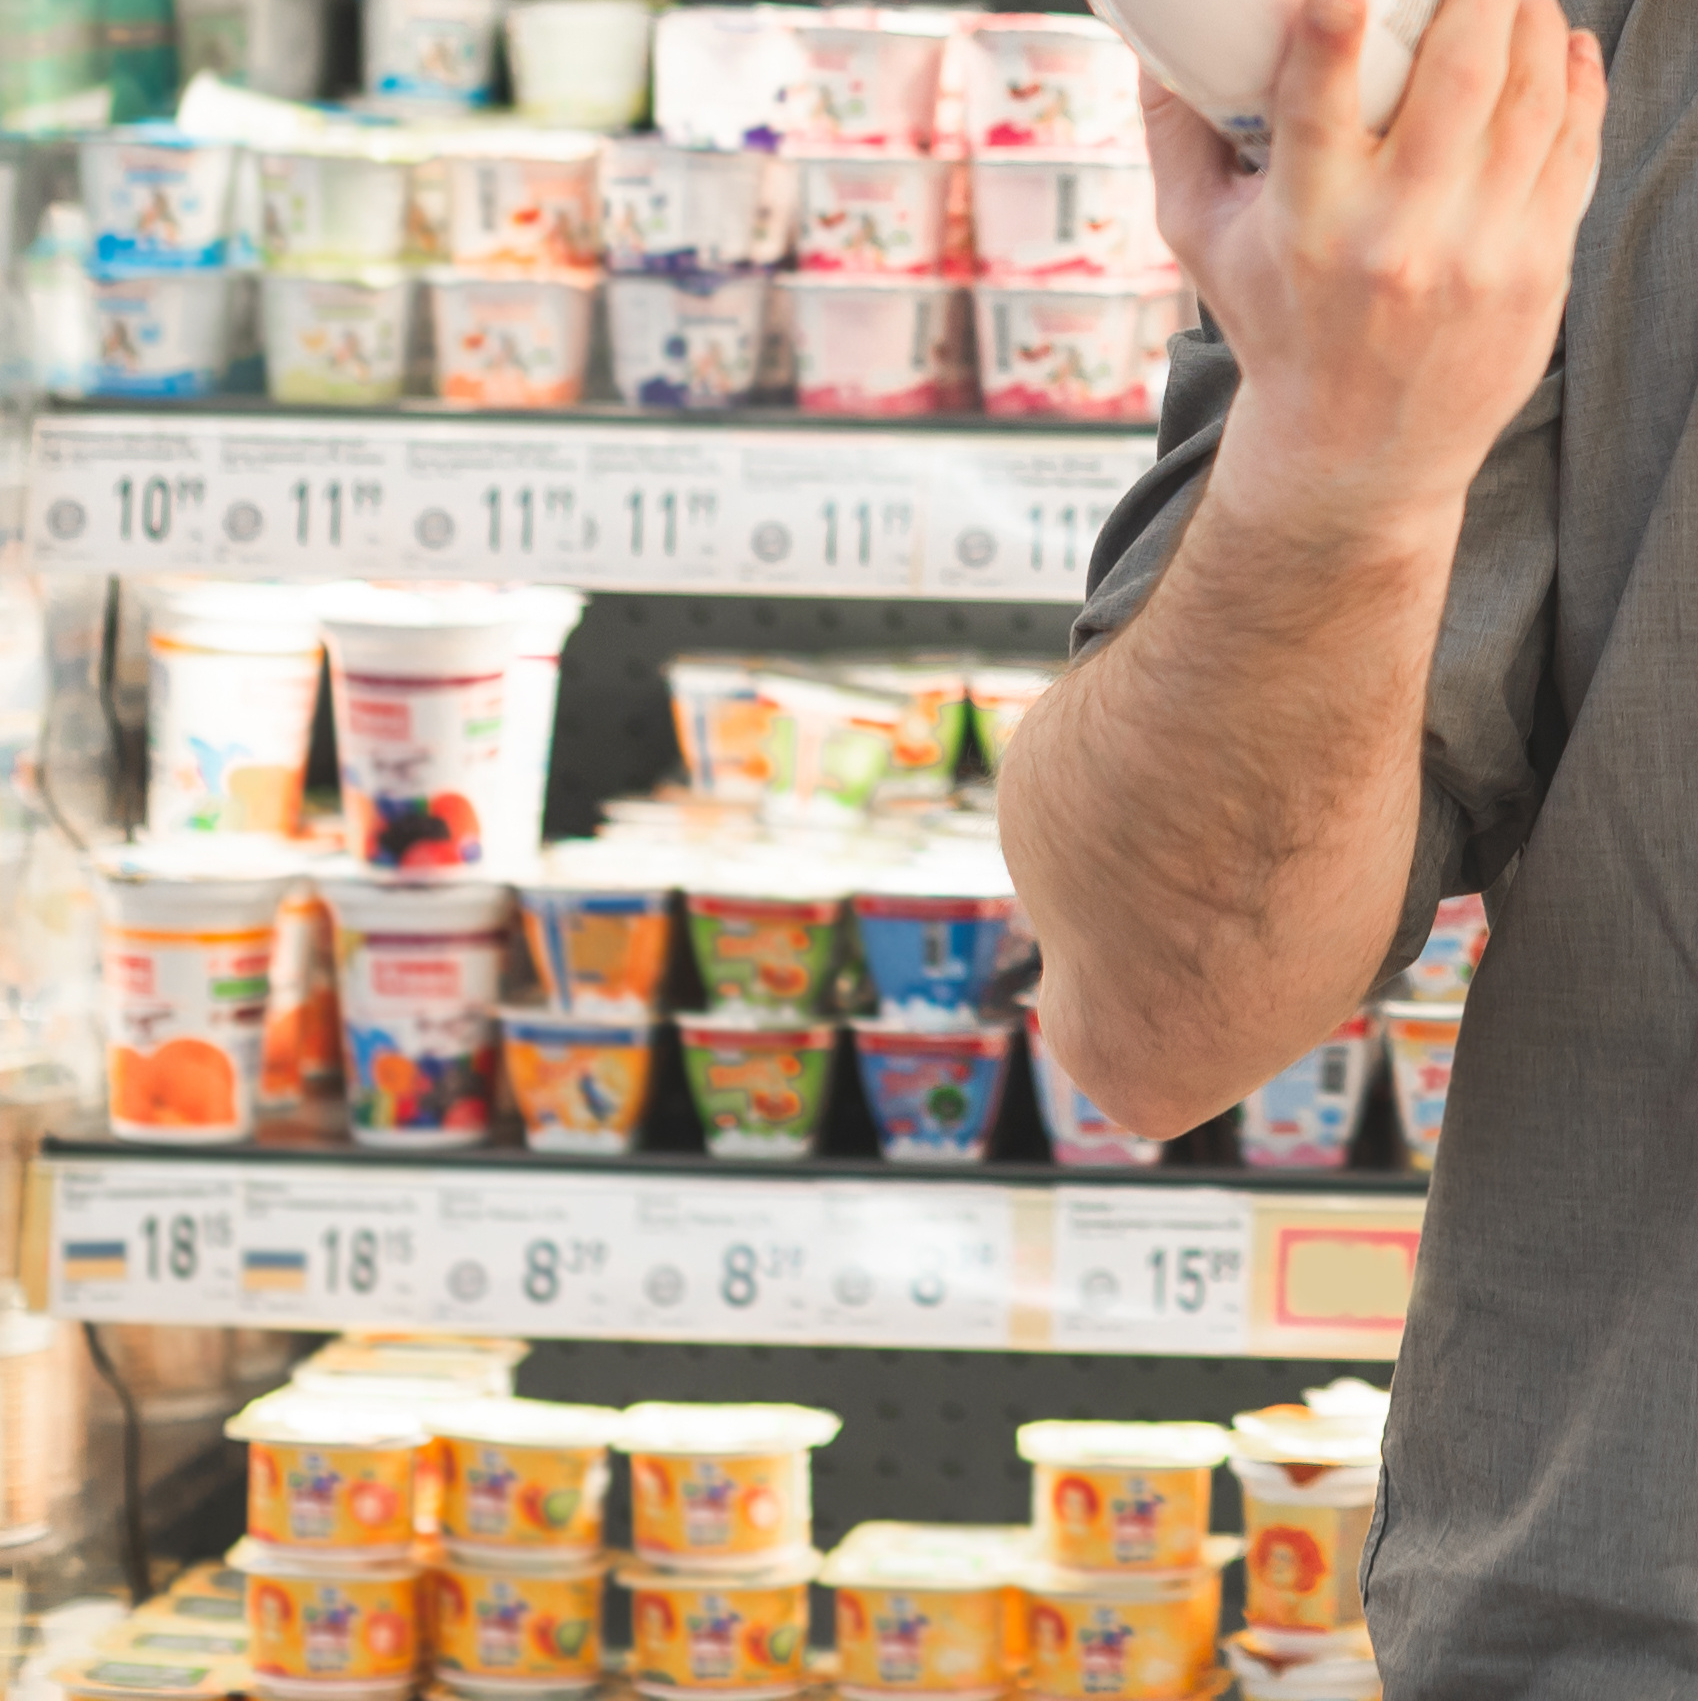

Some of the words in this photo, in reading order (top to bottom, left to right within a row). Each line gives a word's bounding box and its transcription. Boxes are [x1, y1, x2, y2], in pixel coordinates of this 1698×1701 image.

[112, 474, 171, 542] 10
[288, 479, 342, 546] 11
[485, 486, 534, 553] 11
[624, 489, 677, 556] 11
[821, 500, 871, 566] 11
[1030, 504, 1077, 571] 11
[139, 1213, 198, 1282] 18
[320, 1226, 379, 1295] 18
[522, 1239, 561, 1304] 8
[719, 1242, 759, 1308] 8
[1147, 1247, 1207, 1315] 15
